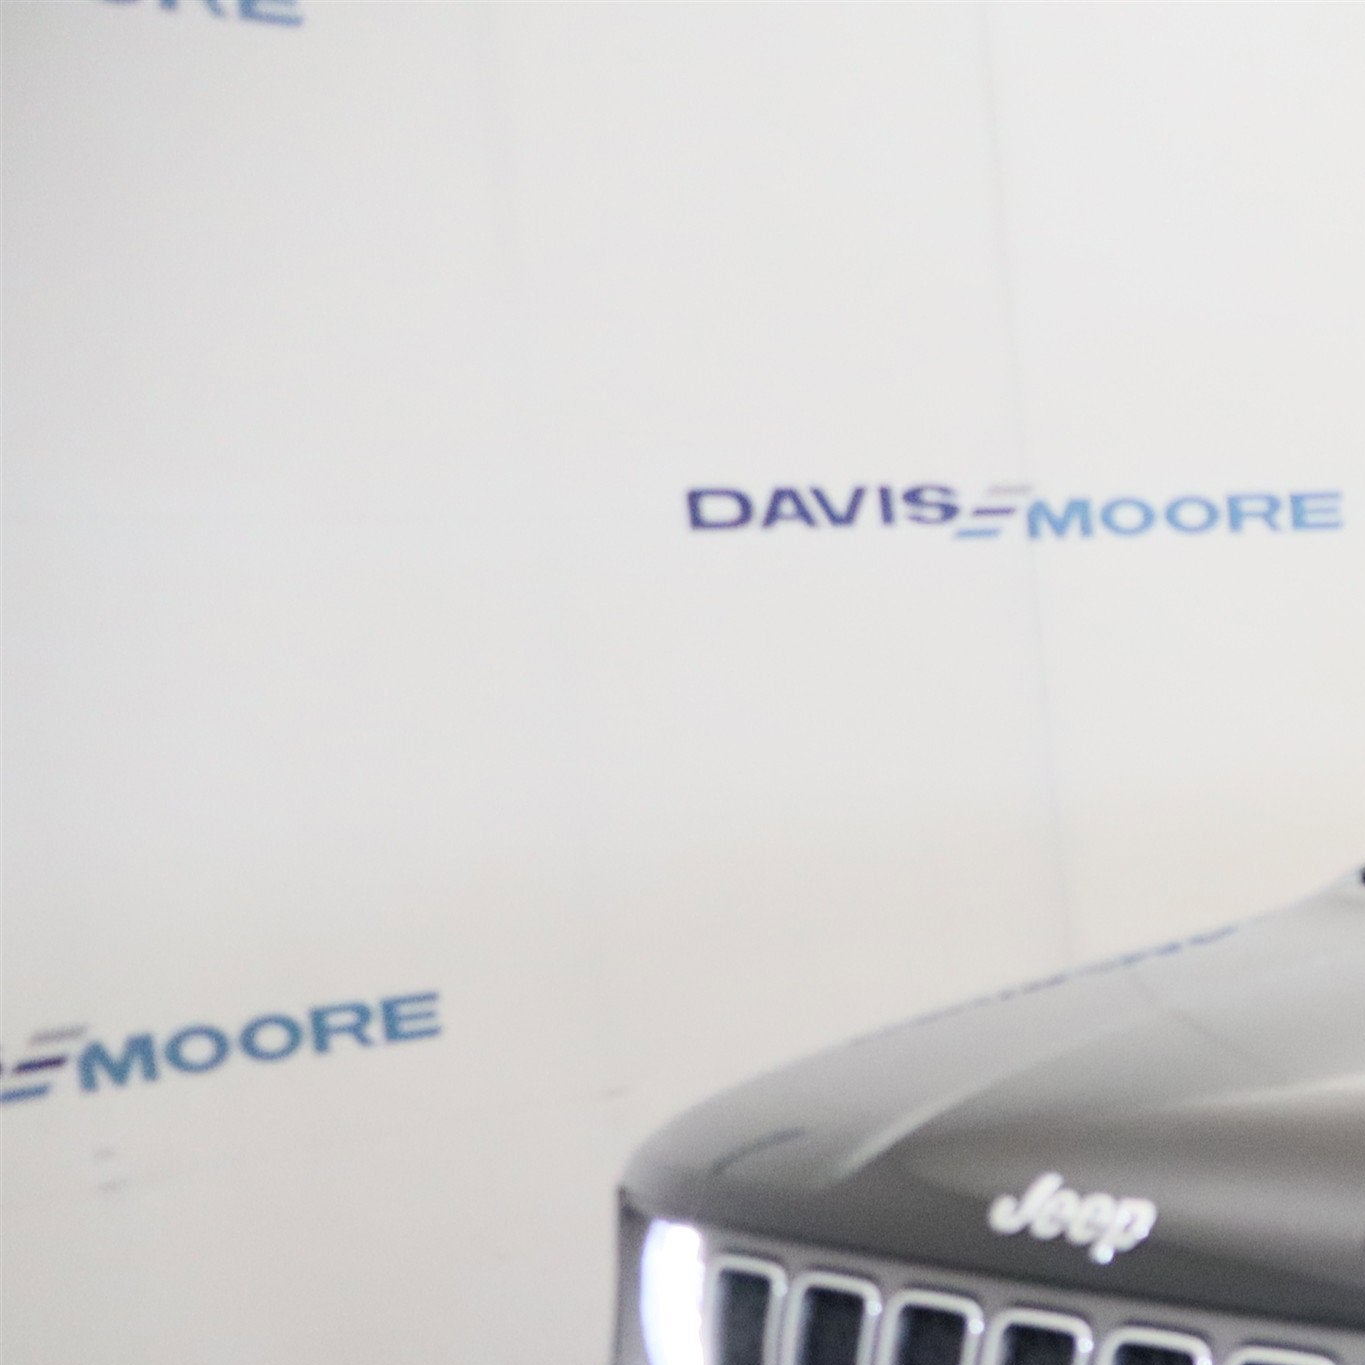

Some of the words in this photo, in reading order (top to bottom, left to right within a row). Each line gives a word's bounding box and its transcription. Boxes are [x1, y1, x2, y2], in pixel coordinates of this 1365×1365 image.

[685, 484, 961, 531] DAVIS
[1025, 491, 1344, 540] MOORE
[77, 991, 443, 1093] MOORE
[988, 1171, 1157, 1264] Jeep
